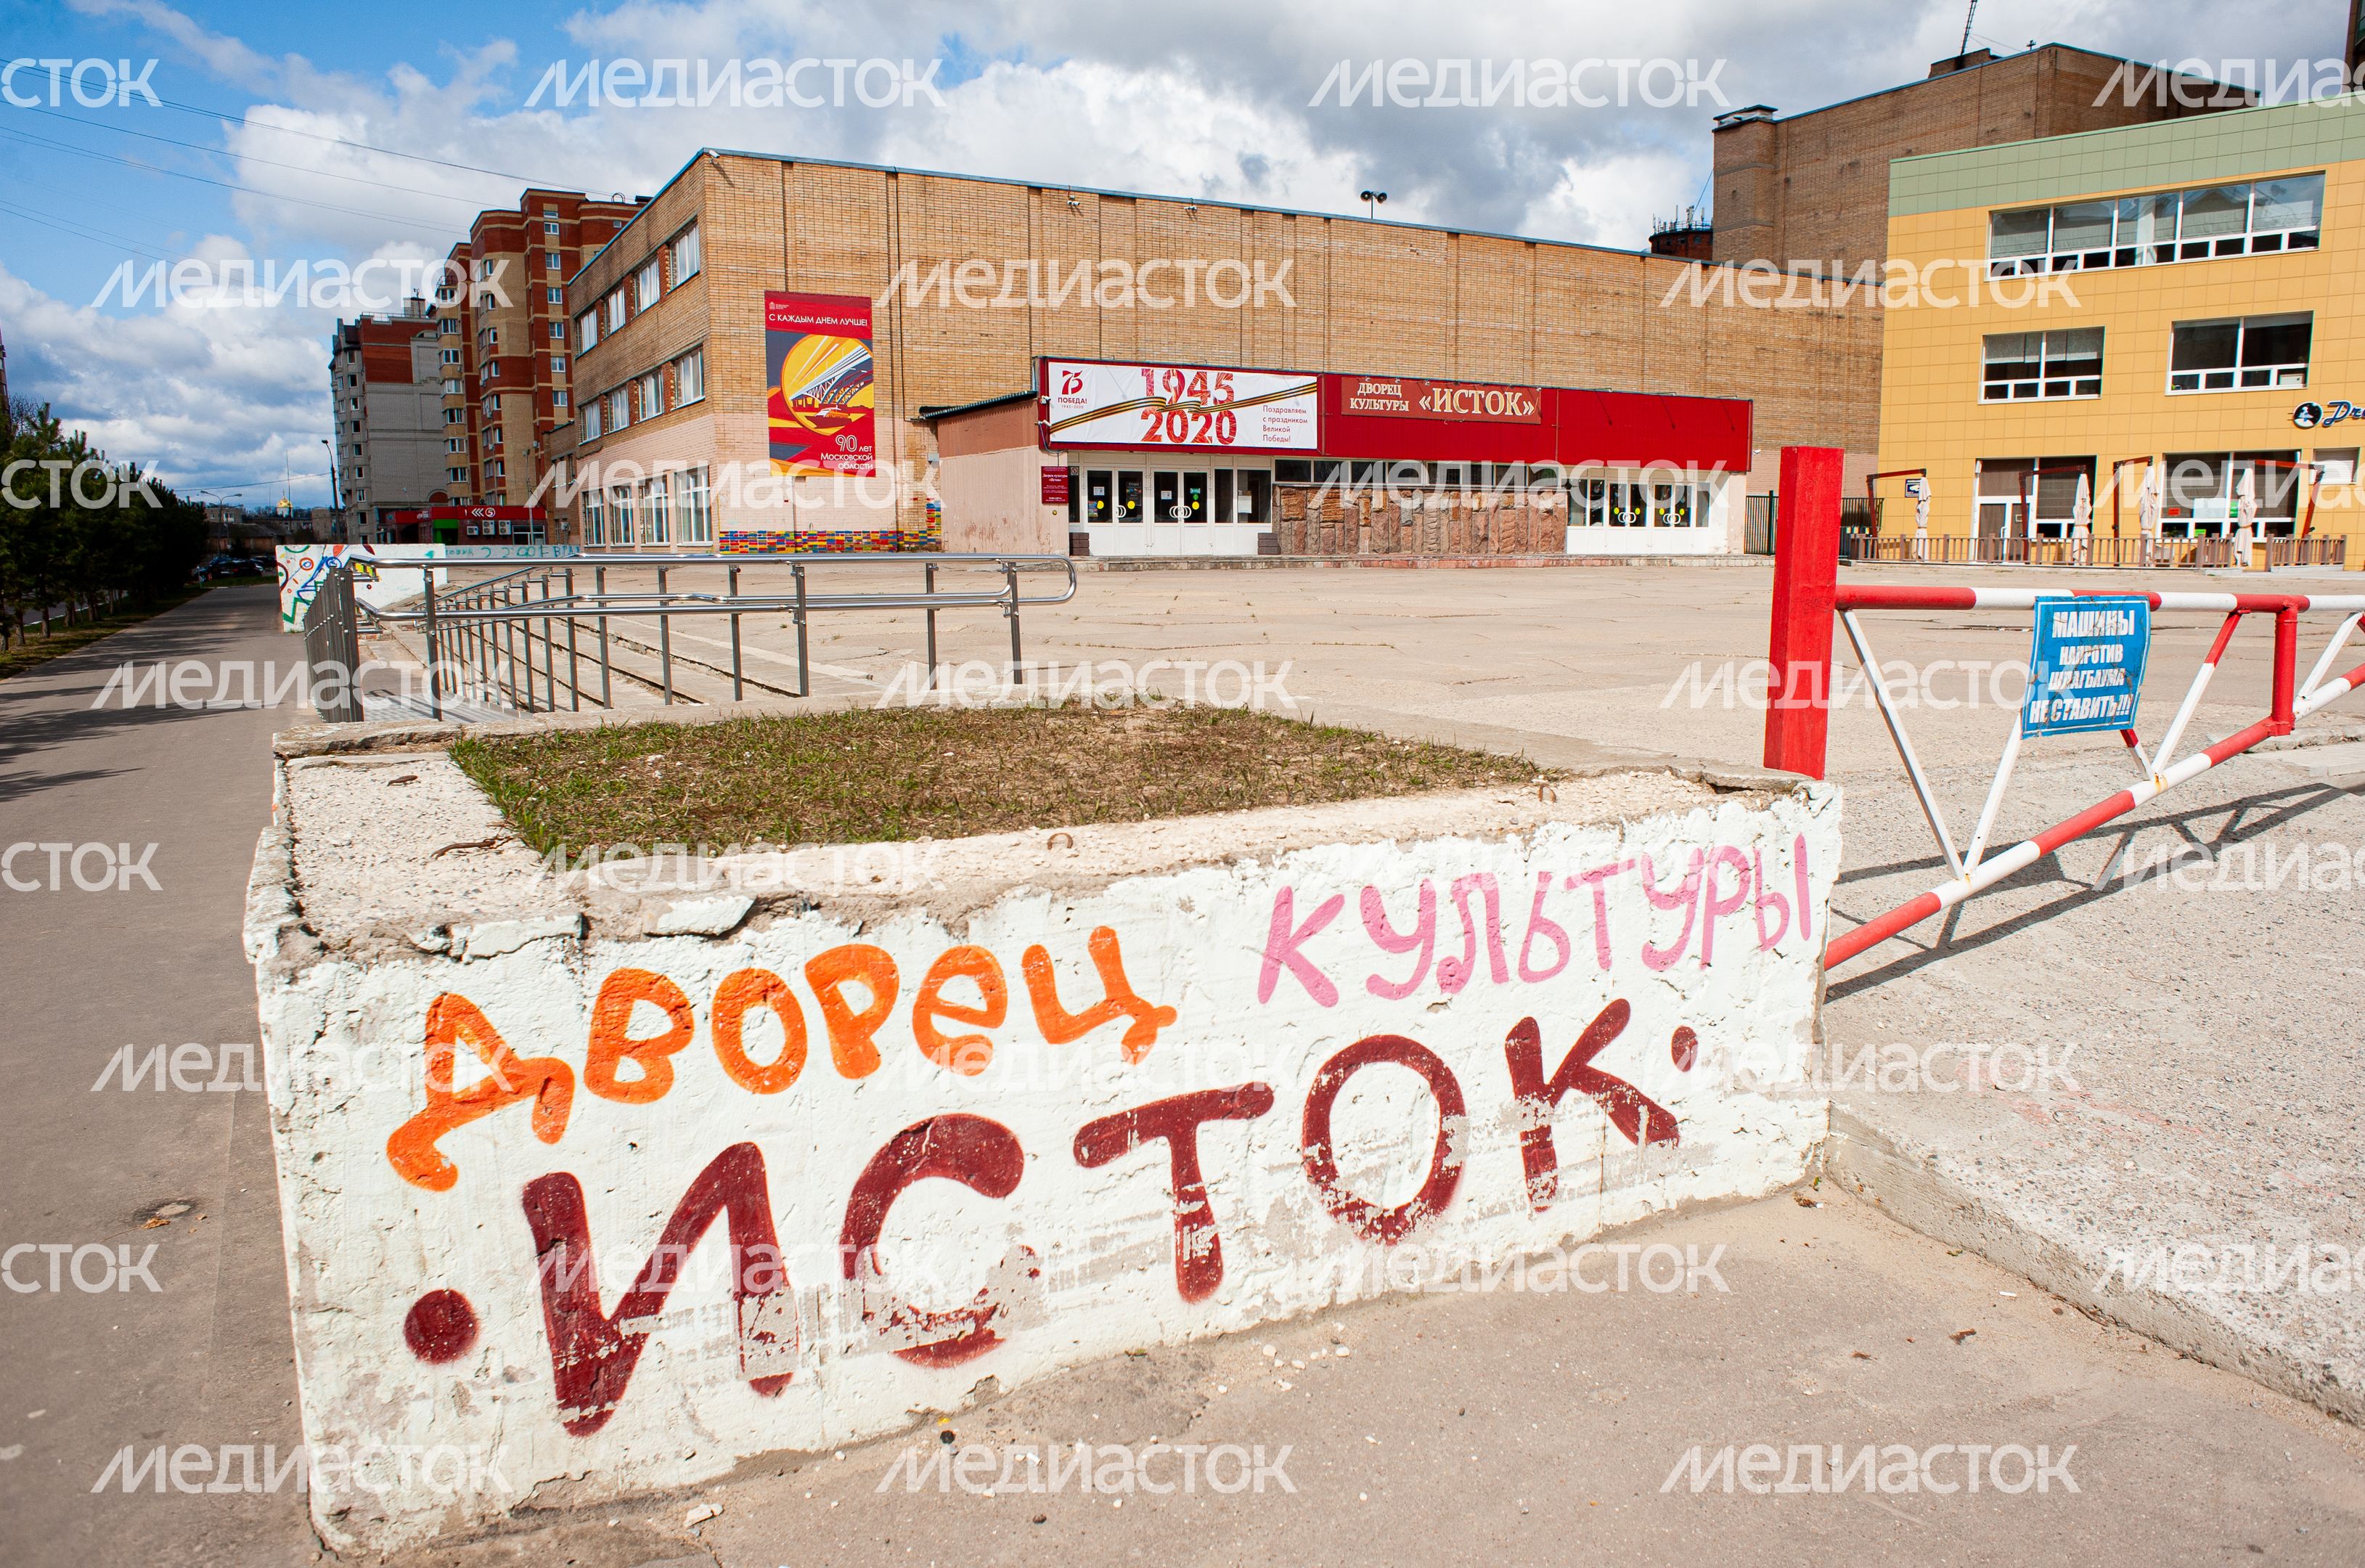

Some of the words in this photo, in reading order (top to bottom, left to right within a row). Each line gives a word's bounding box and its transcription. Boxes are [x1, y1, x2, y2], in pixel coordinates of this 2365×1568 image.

[777, 314, 814, 323] КАЖДЫМ
[1062, 370, 1082, 395] 75
[1141, 368, 1234, 405] 1945
[1357, 383, 1402, 398] ДВОРЕЦ
[1263, 405, 1307, 415] Поздравляем
[1349, 398, 1409, 412] КУЛЬТУРЫ
[1418, 388, 1535, 416] «ИСТОК»
[2323, 401, 2365, 427] Dr
[1140, 407, 1236, 445] 2020
[836, 434, 857, 452] 90
[838, 461, 873, 470] области
[2051, 610, 2135, 638] МАШИНЫ
[2059, 644, 2123, 666] НАПРОТИВ
[2048, 668, 2126, 690] ШЛАГБАУМА
